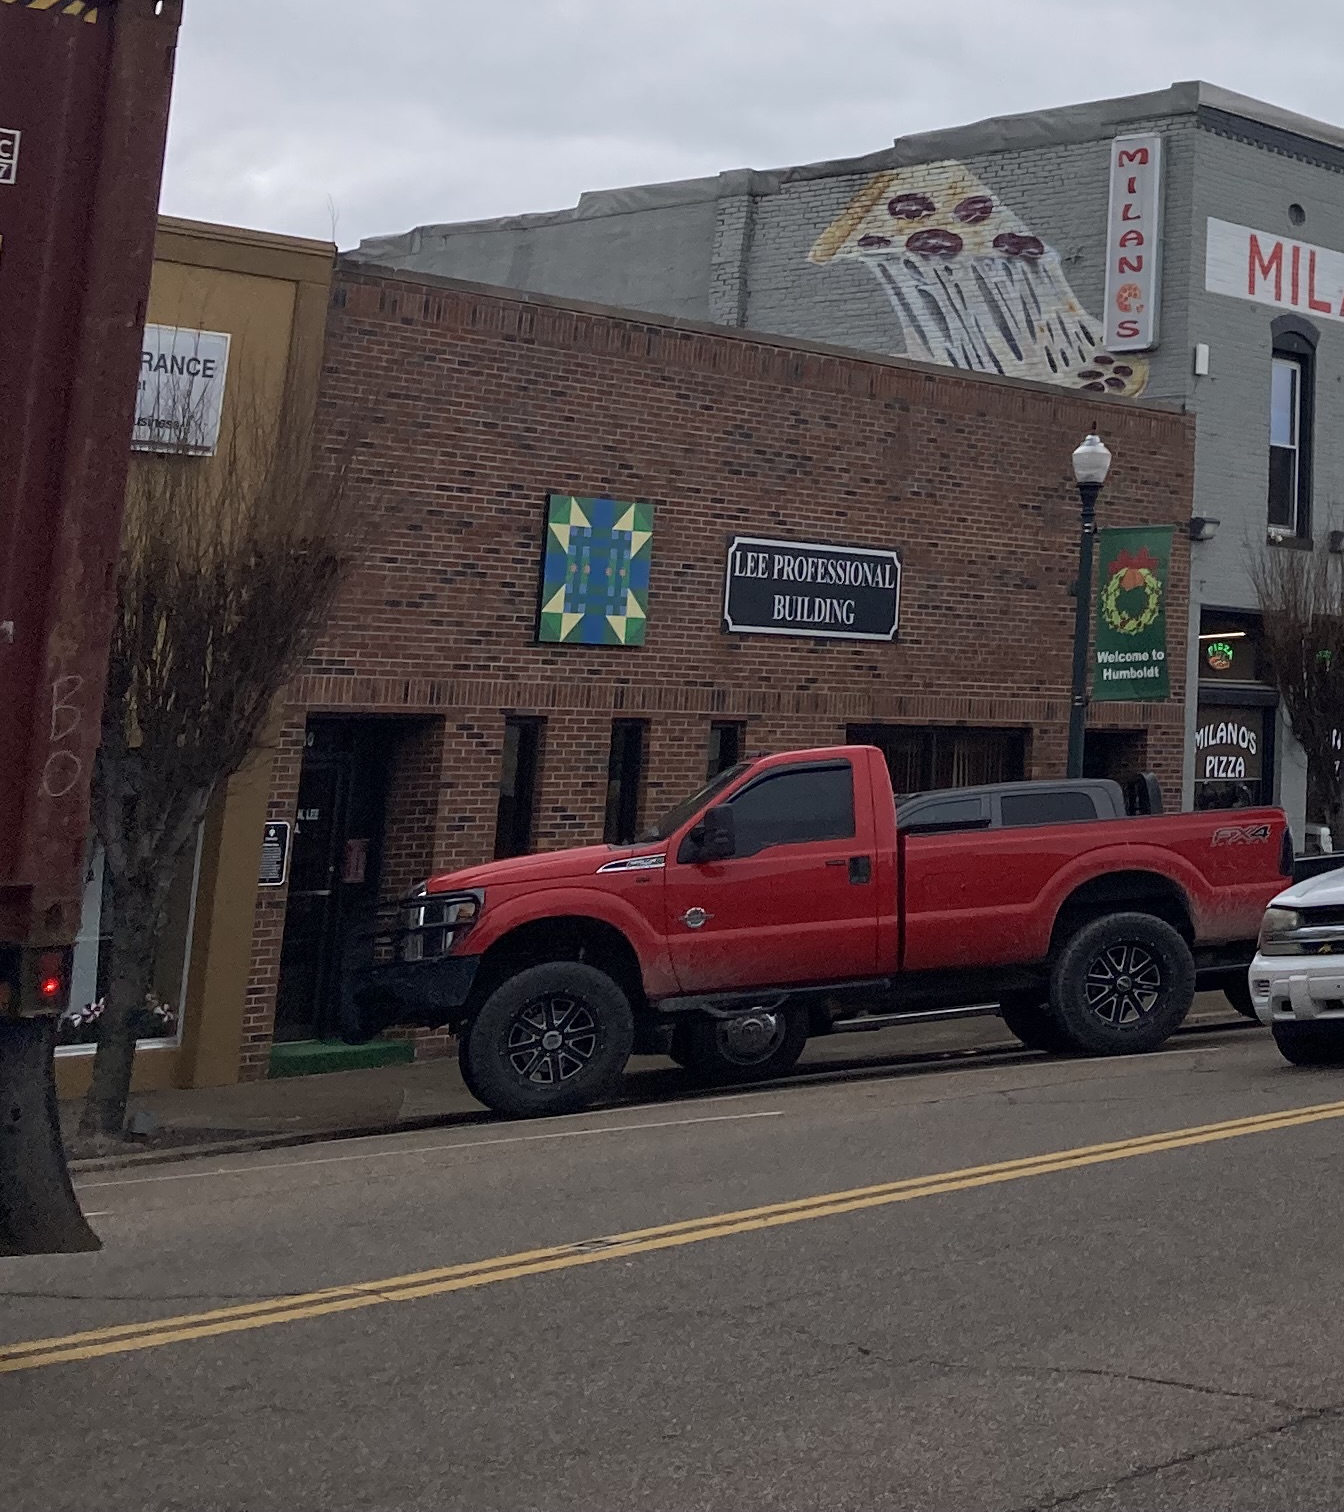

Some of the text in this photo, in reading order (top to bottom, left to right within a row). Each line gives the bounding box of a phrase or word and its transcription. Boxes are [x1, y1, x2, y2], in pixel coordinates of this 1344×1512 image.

[734, 551, 895, 589] LEE PROFESSIONAL
[772, 595, 856, 625] BUILDING
[1097, 649, 1165, 663] Welcome to
[1208, 642, 1234, 661] PIZZA
[1103, 666, 1160, 681] Humboldt
[1195, 722, 1257, 755] MILANO'S
[1206, 756, 1246, 778] PIZZA
[1210, 824, 1271, 846] FX4
